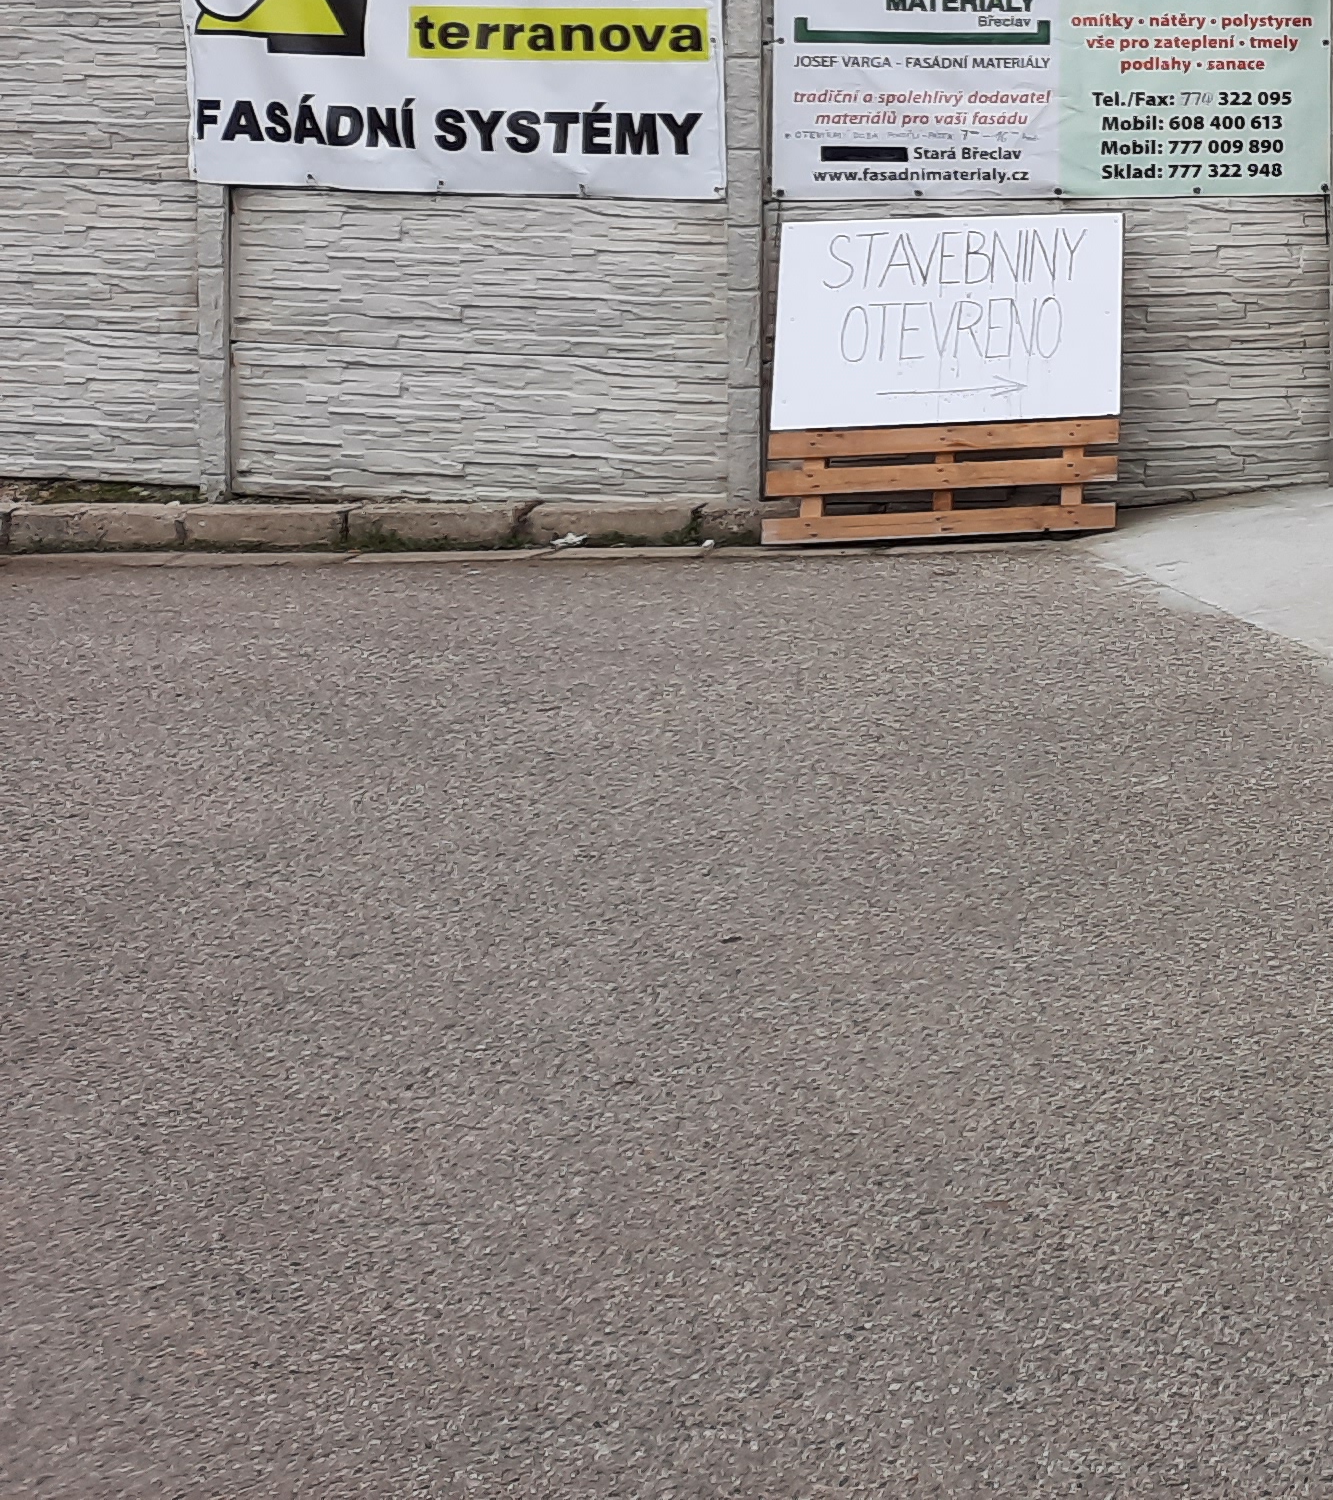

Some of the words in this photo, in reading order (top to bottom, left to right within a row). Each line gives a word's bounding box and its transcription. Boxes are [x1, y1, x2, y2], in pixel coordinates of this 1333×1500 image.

[978, 15, 1031, 27] Břeclav
[1071, 14, 1133, 29] omítky
[1149, 14, 1206, 30] nátěry
[1221, 15, 1313, 30] polystyren
[415, 15, 703, 52] terranova
[1086, 35, 1115, 49] vše
[1119, 39, 1150, 52] pro
[1154, 36, 1234, 52] zateplení
[1250, 36, 1299, 51] tmely
[794, 56, 837, 67] JOSEF
[843, 57, 892, 68] VARGA
[905, 56, 967, 68] FASÁDNÍ
[972, 55, 1050, 69] MATERIÁLY
[1120, 57, 1192, 74] podlahy
[1207, 60, 1265, 70] sanace
[794, 91, 858, 104] tradiční
[863, 95, 873, 104] a
[878, 91, 962, 107] spolehlivý
[967, 90, 1051, 104] dodavatel
[1092, 91, 1175, 107] Tel./Fax:
[1218, 92, 1252, 105] 322
[1258, 92, 1292, 105] 095
[196, 94, 416, 149] FASÁDNÍ
[434, 102, 704, 155] SYSTÉMY
[815, 111, 897, 125] materiálů
[901, 115, 929, 127] pro
[936, 112, 966, 125] vaši
[971, 111, 1028, 125] fasádu
[1101, 115, 1164, 131] Mobil:
[1169, 116, 1205, 130] 608
[1210, 116, 1246, 130] 400
[1250, 116, 1283, 130] 613
[913, 146, 956, 160] Stará
[961, 146, 1022, 160] Břeclav
[1100, 139, 1163, 155] Mobil:
[1168, 140, 1203, 154] 777
[1208, 140, 1244, 154] 009
[1249, 139, 1284, 154] 890
[813, 167, 1029, 183] www.fasadnimaterialy.cz
[1101, 164, 1163, 179] Sklad:
[1168, 164, 1203, 179] 777
[1208, 164, 1242, 178] 322
[1247, 163, 1283, 178] 948
[823, 228, 1088, 289] STAVEBNINY
